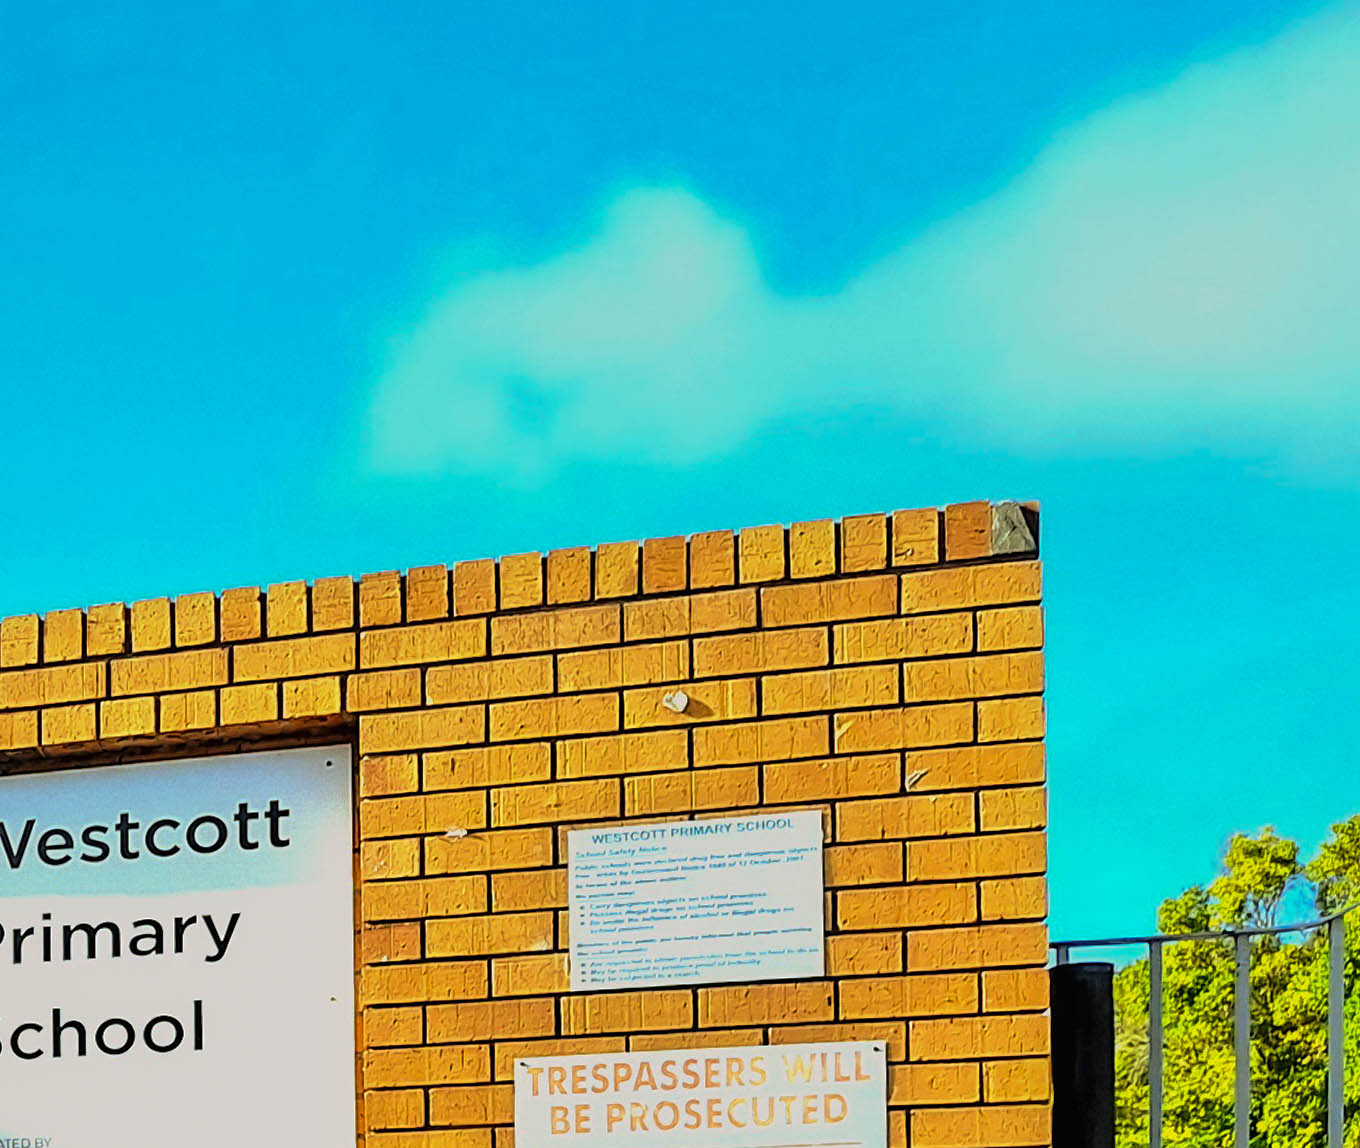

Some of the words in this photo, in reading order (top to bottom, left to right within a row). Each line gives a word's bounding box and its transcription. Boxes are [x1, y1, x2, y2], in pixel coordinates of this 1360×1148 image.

[591, 828, 668, 844] WESTCOTT
[671, 823, 732, 838] PRIMARY
[736, 818, 795, 833] SCHOOL
[526, 1055, 768, 1096] TRESPASSERS
[781, 1050, 871, 1085] WILL
[549, 1103, 592, 1135] BE
[606, 1093, 849, 1133] PROSECUTED
[34, 1137, 52, 1148] BY
